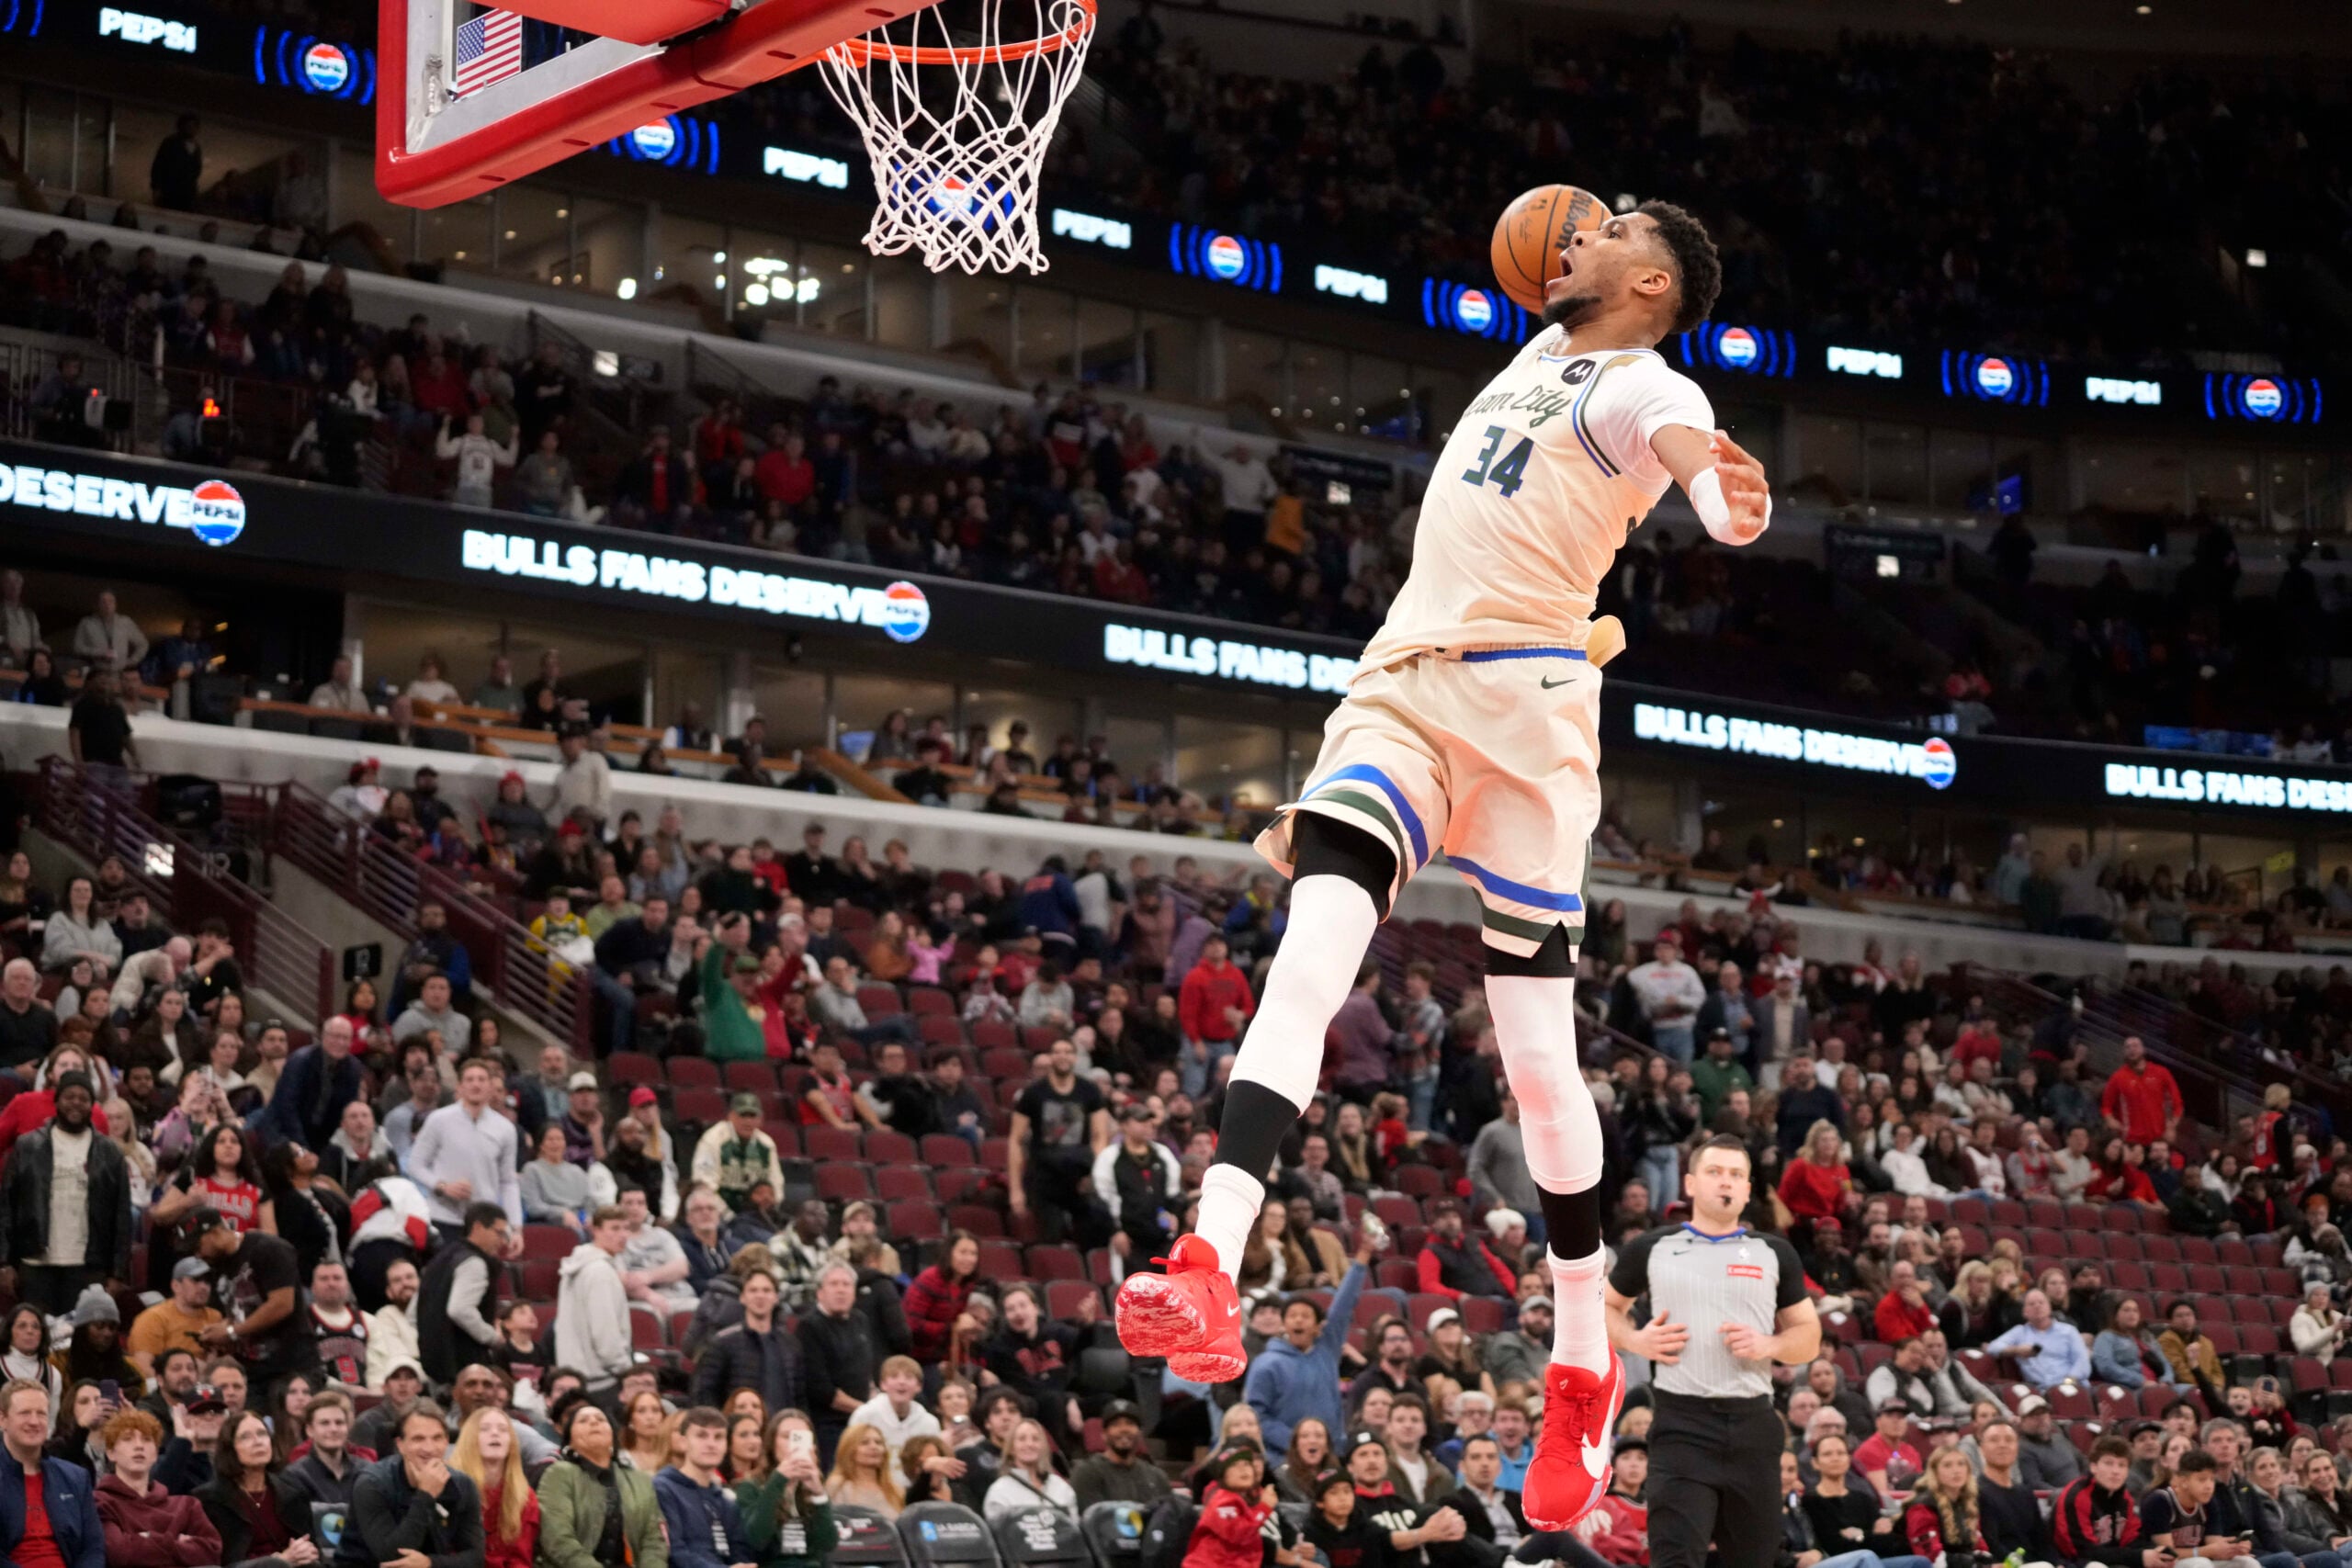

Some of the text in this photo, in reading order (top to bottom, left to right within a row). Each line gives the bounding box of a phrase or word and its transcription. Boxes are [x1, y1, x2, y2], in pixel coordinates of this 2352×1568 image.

[99, 8, 197, 52] PEPSI
[763, 146, 848, 189] PEPSI
[1052, 209, 1131, 250] PEPSI
[1315, 265, 1387, 303] PEPSI
[1827, 346, 1902, 378] PEPSI
[1510, 384, 1572, 429] City
[2086, 377, 2161, 404] PEPSI
[1461, 424, 1534, 499] 34
[193, 502, 241, 521] PEPSI
[462, 530, 598, 586] BULLS
[600, 549, 707, 602] FANS
[709, 565, 886, 627] DESERVE
[1104, 624, 1360, 695] BULLS FANS DE
[1634, 703, 1926, 778] BULLS FANS DESERVE
[2105, 763, 2205, 801] BULLS
[2205, 771, 2286, 807] FANS
